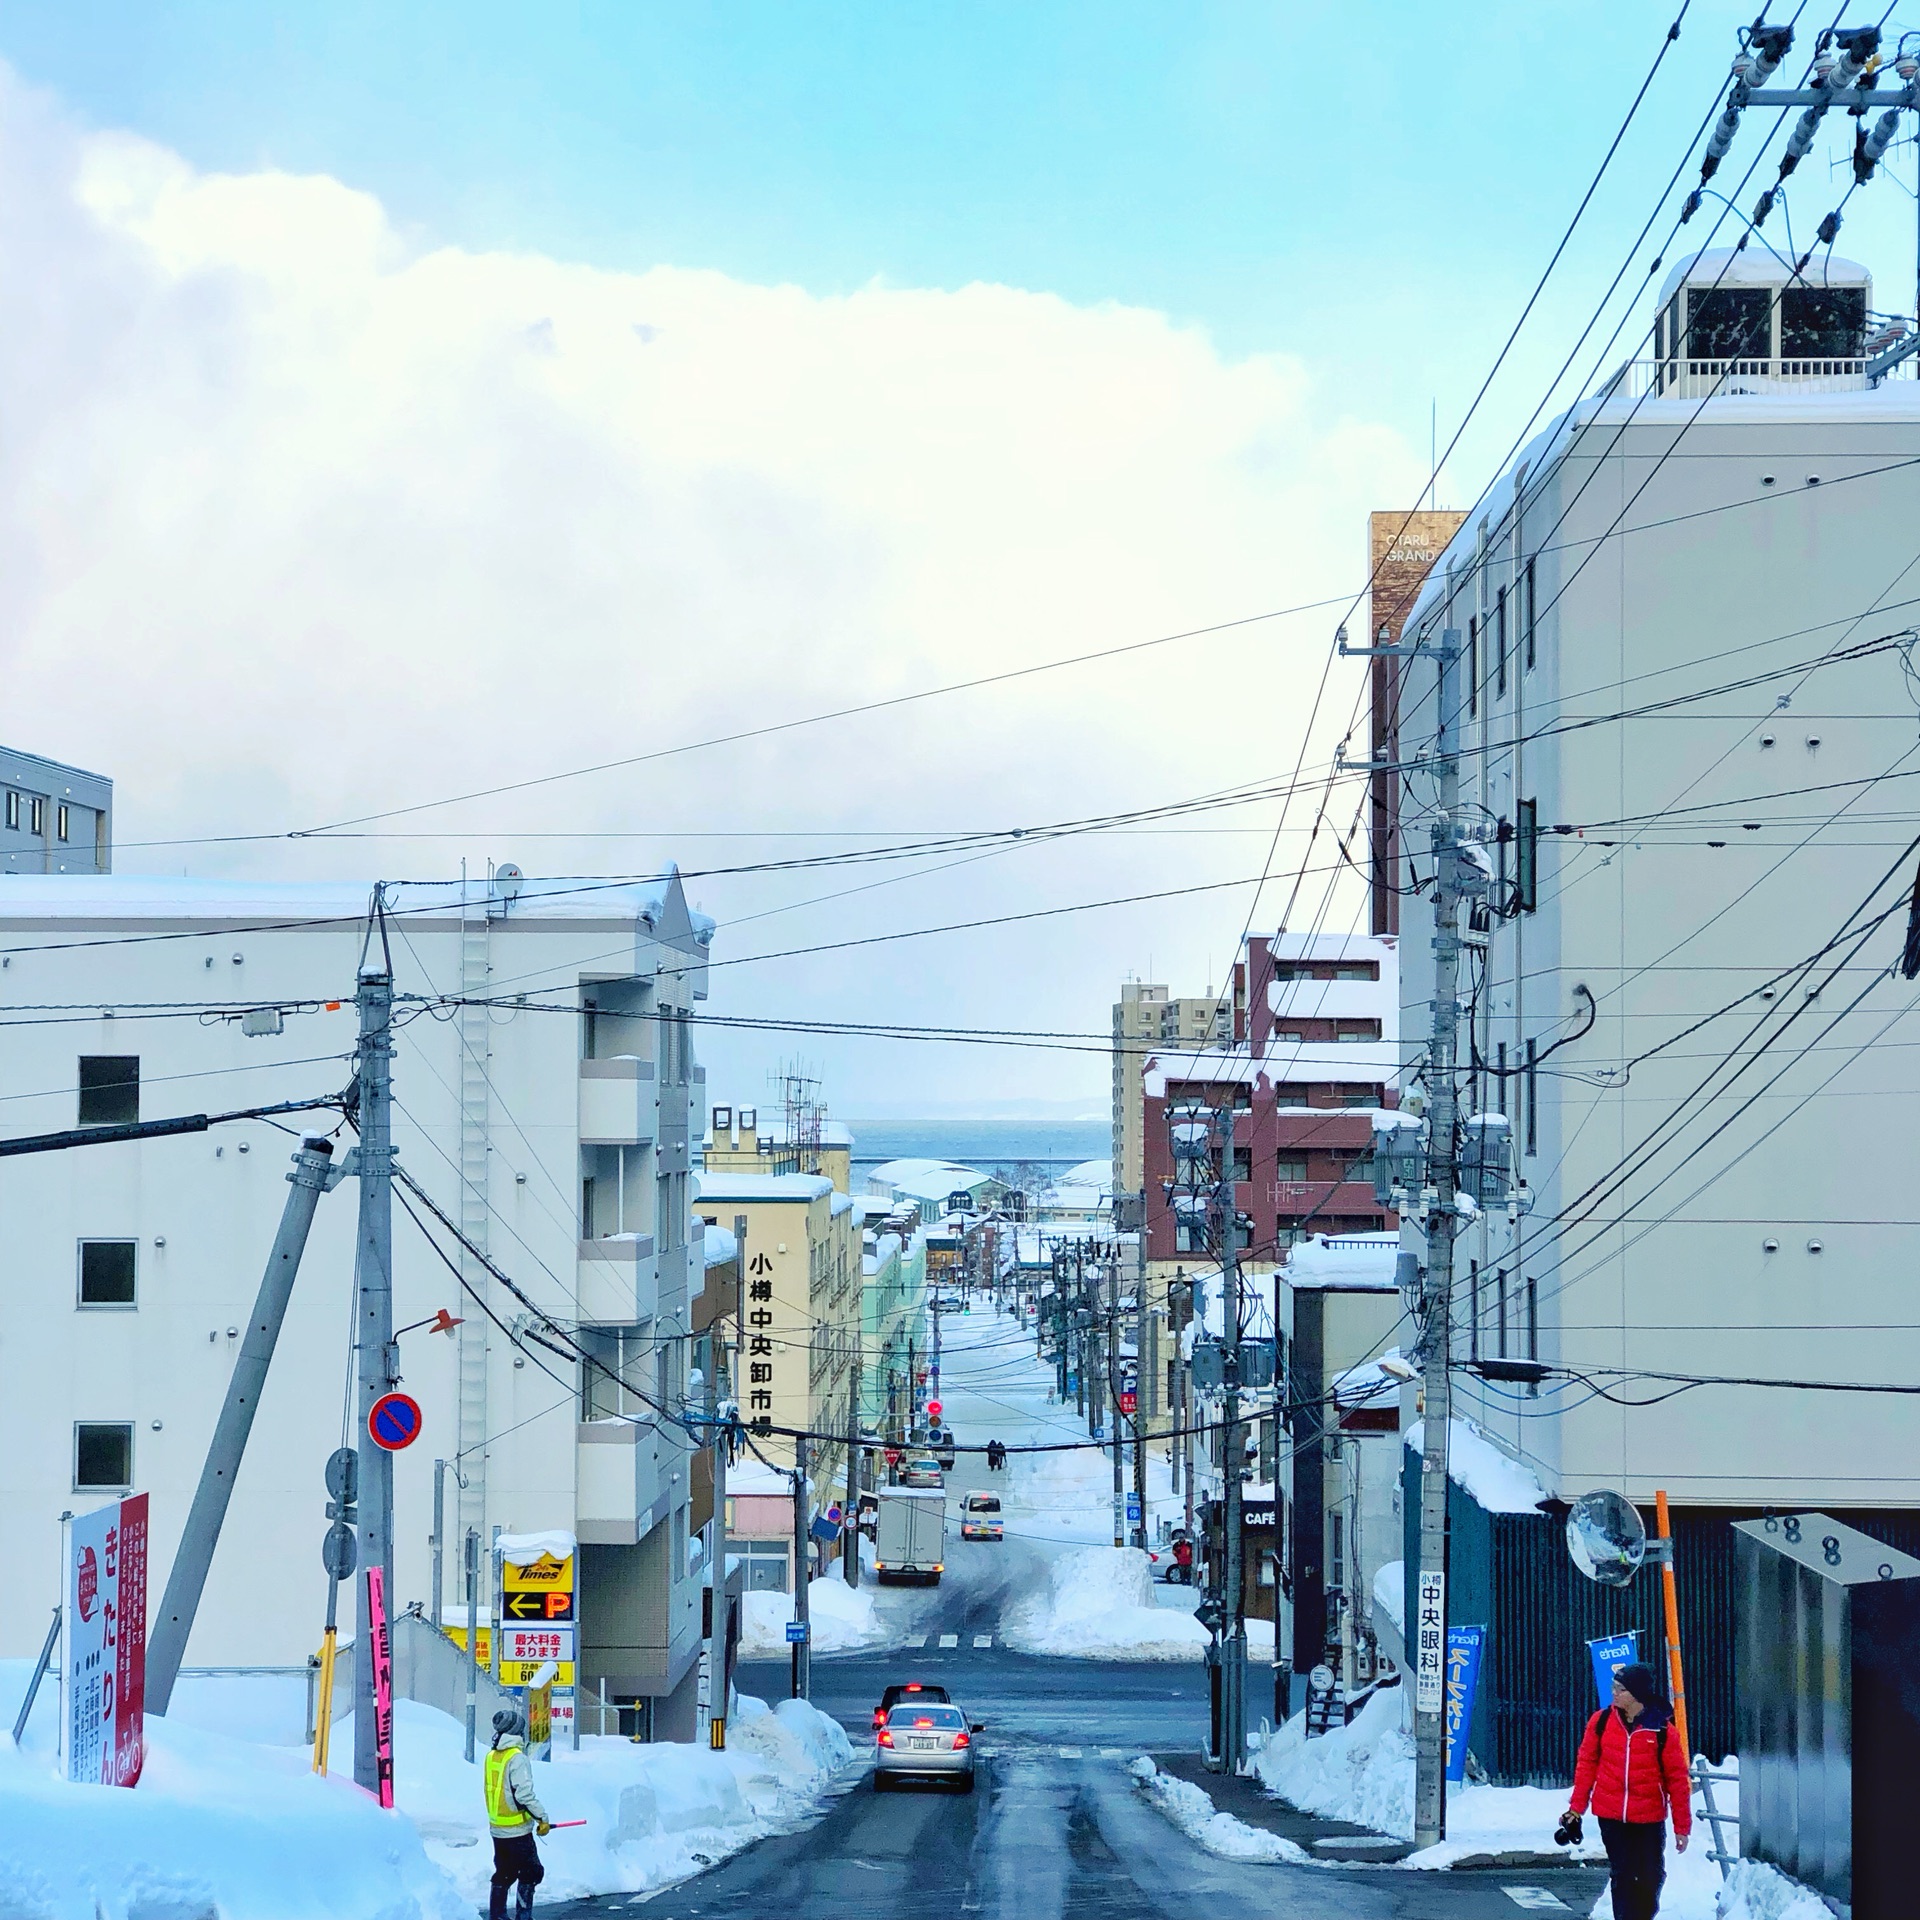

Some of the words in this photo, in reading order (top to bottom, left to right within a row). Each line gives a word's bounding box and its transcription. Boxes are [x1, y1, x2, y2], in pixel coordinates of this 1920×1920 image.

[1386, 535, 1430, 546] OTARU
[1386, 550, 1435, 561] GRAND
[1123, 1378, 1137, 1393] P
[1245, 1511, 1276, 1525] CAFÉ
[517, 1566, 560, 1581] Times
[545, 1591, 571, 1618] P
[1420, 1586, 1441, 1672] 中央眼科
[515, 1634, 561, 1646] 最大料金
[102, 1526, 117, 1785] きたりん
[515, 1647, 561, 1658] あります
